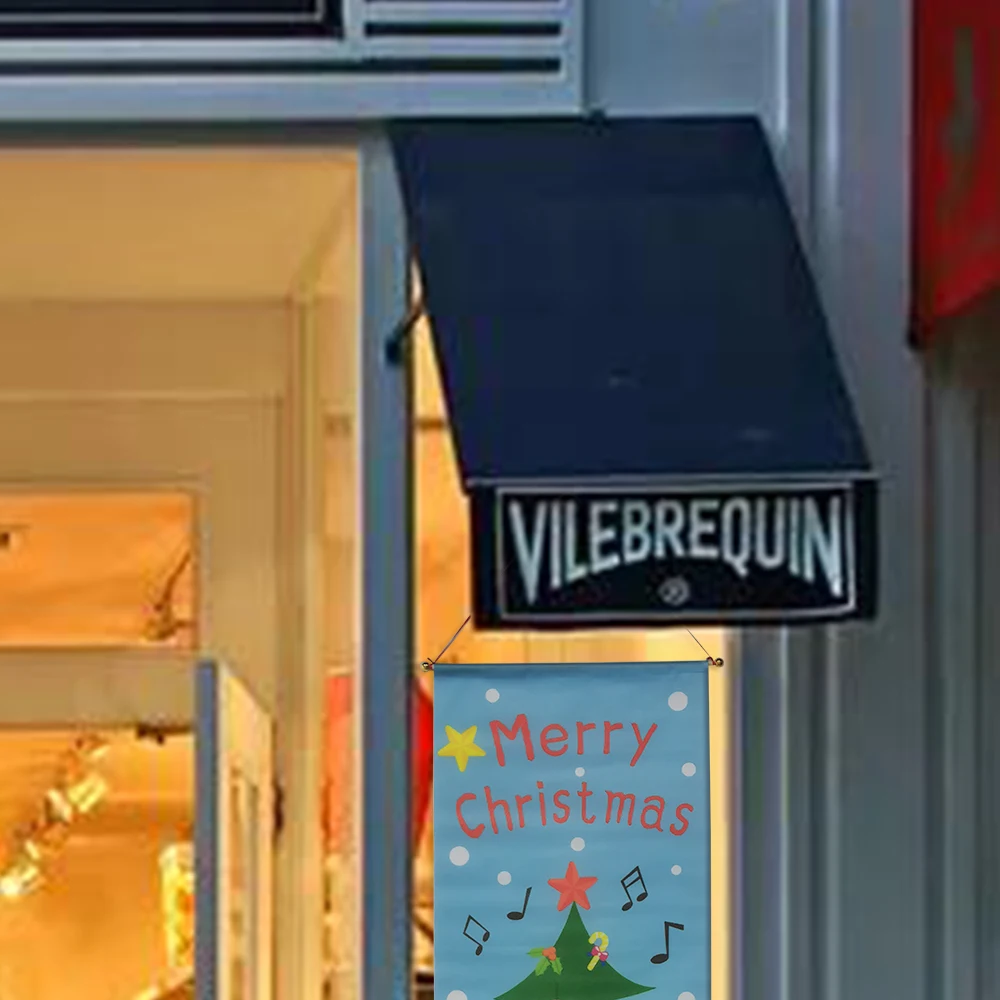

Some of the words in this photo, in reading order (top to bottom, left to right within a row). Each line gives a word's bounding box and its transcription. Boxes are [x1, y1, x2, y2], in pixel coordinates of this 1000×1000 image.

[509, 496, 842, 605] VILEBREQUIN
[489, 713, 658, 767] Merry
[455, 781, 694, 838] Christmas
